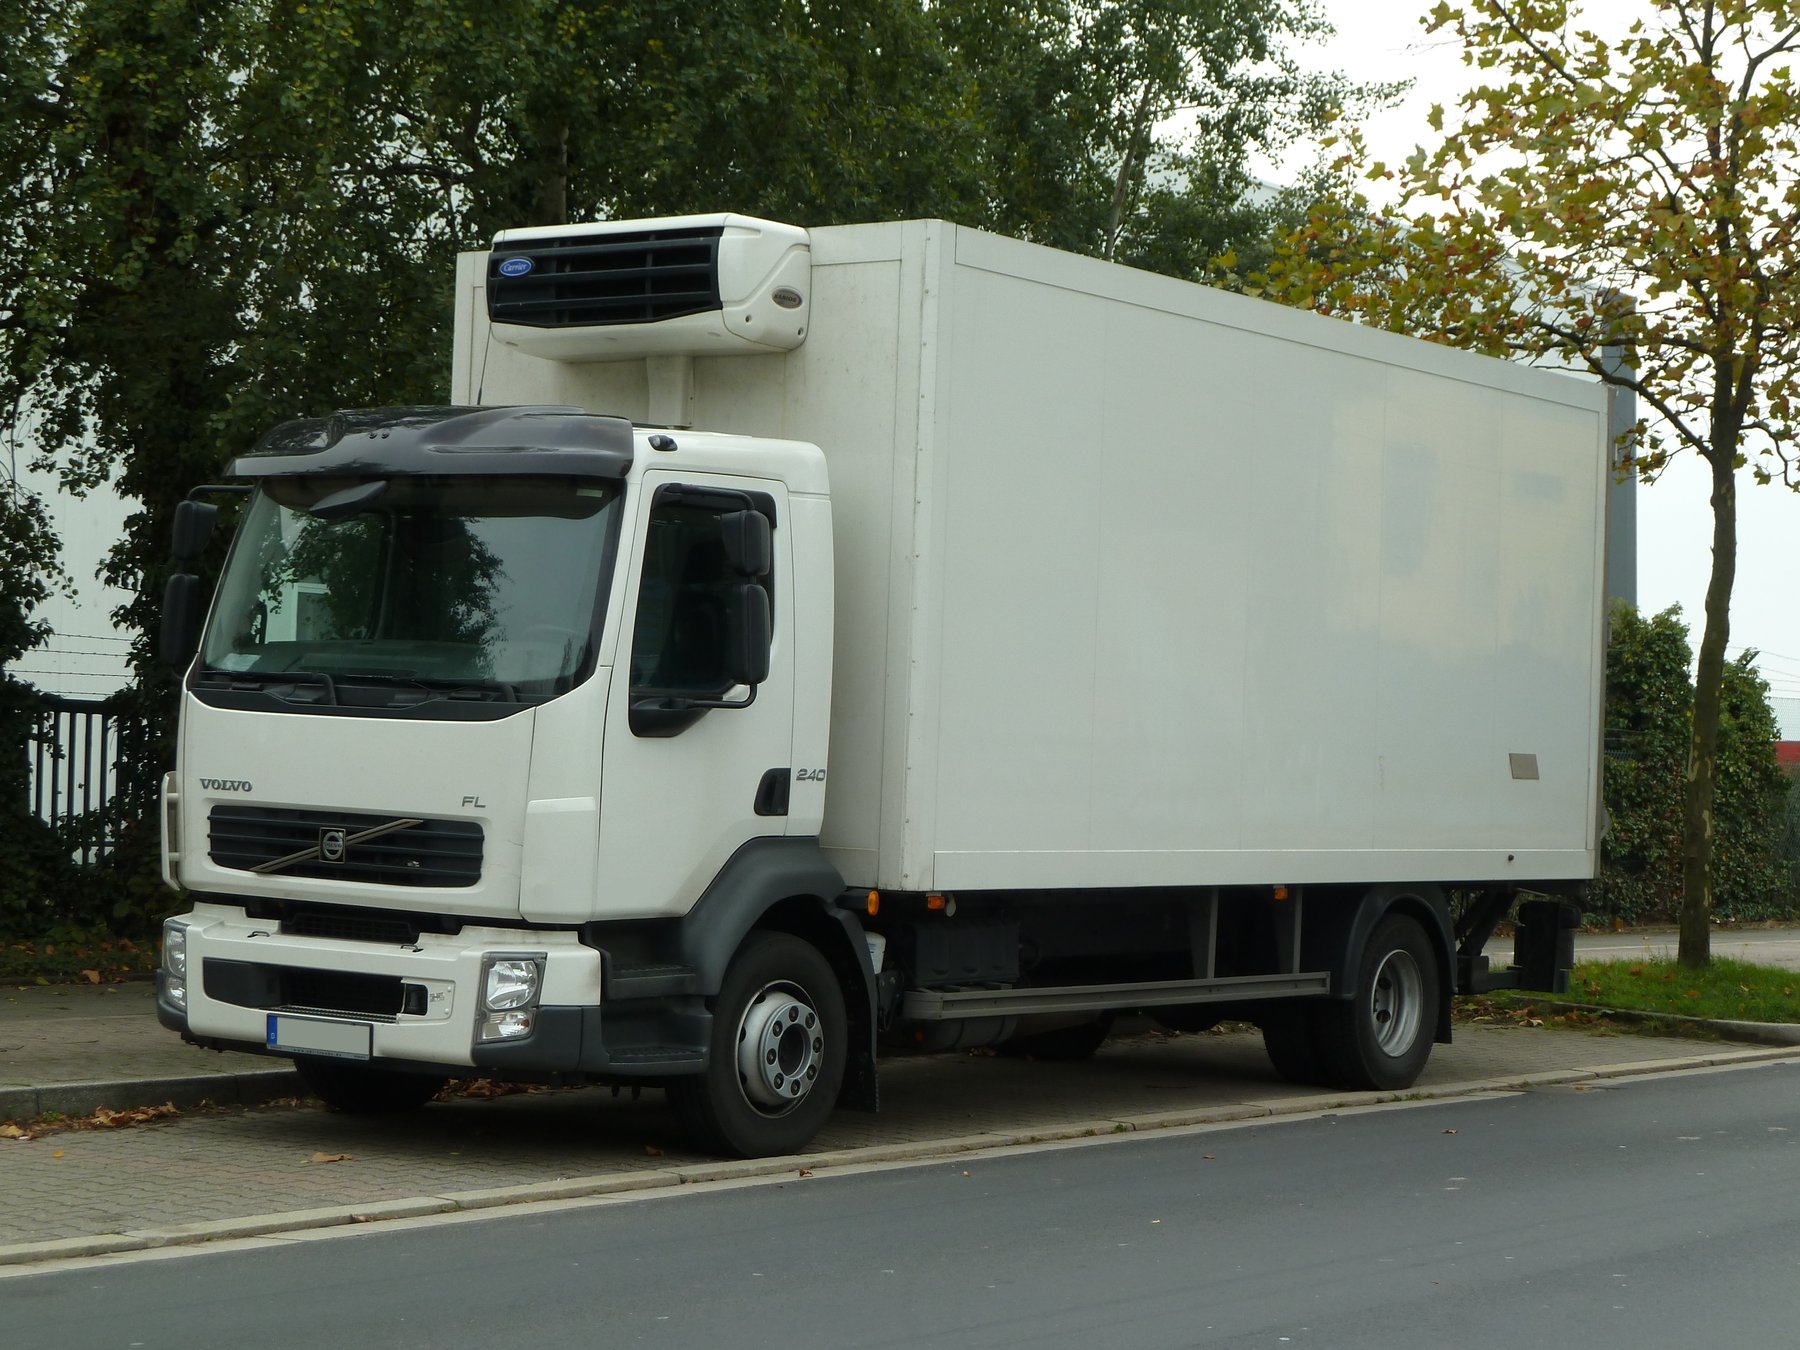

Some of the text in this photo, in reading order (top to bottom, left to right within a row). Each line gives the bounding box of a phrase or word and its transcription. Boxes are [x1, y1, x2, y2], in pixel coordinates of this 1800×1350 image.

[503, 263, 527, 271] Carrier
[796, 768, 826, 781] 240
[199, 778, 253, 792] VOLVO
[461, 796, 486, 808] FL
